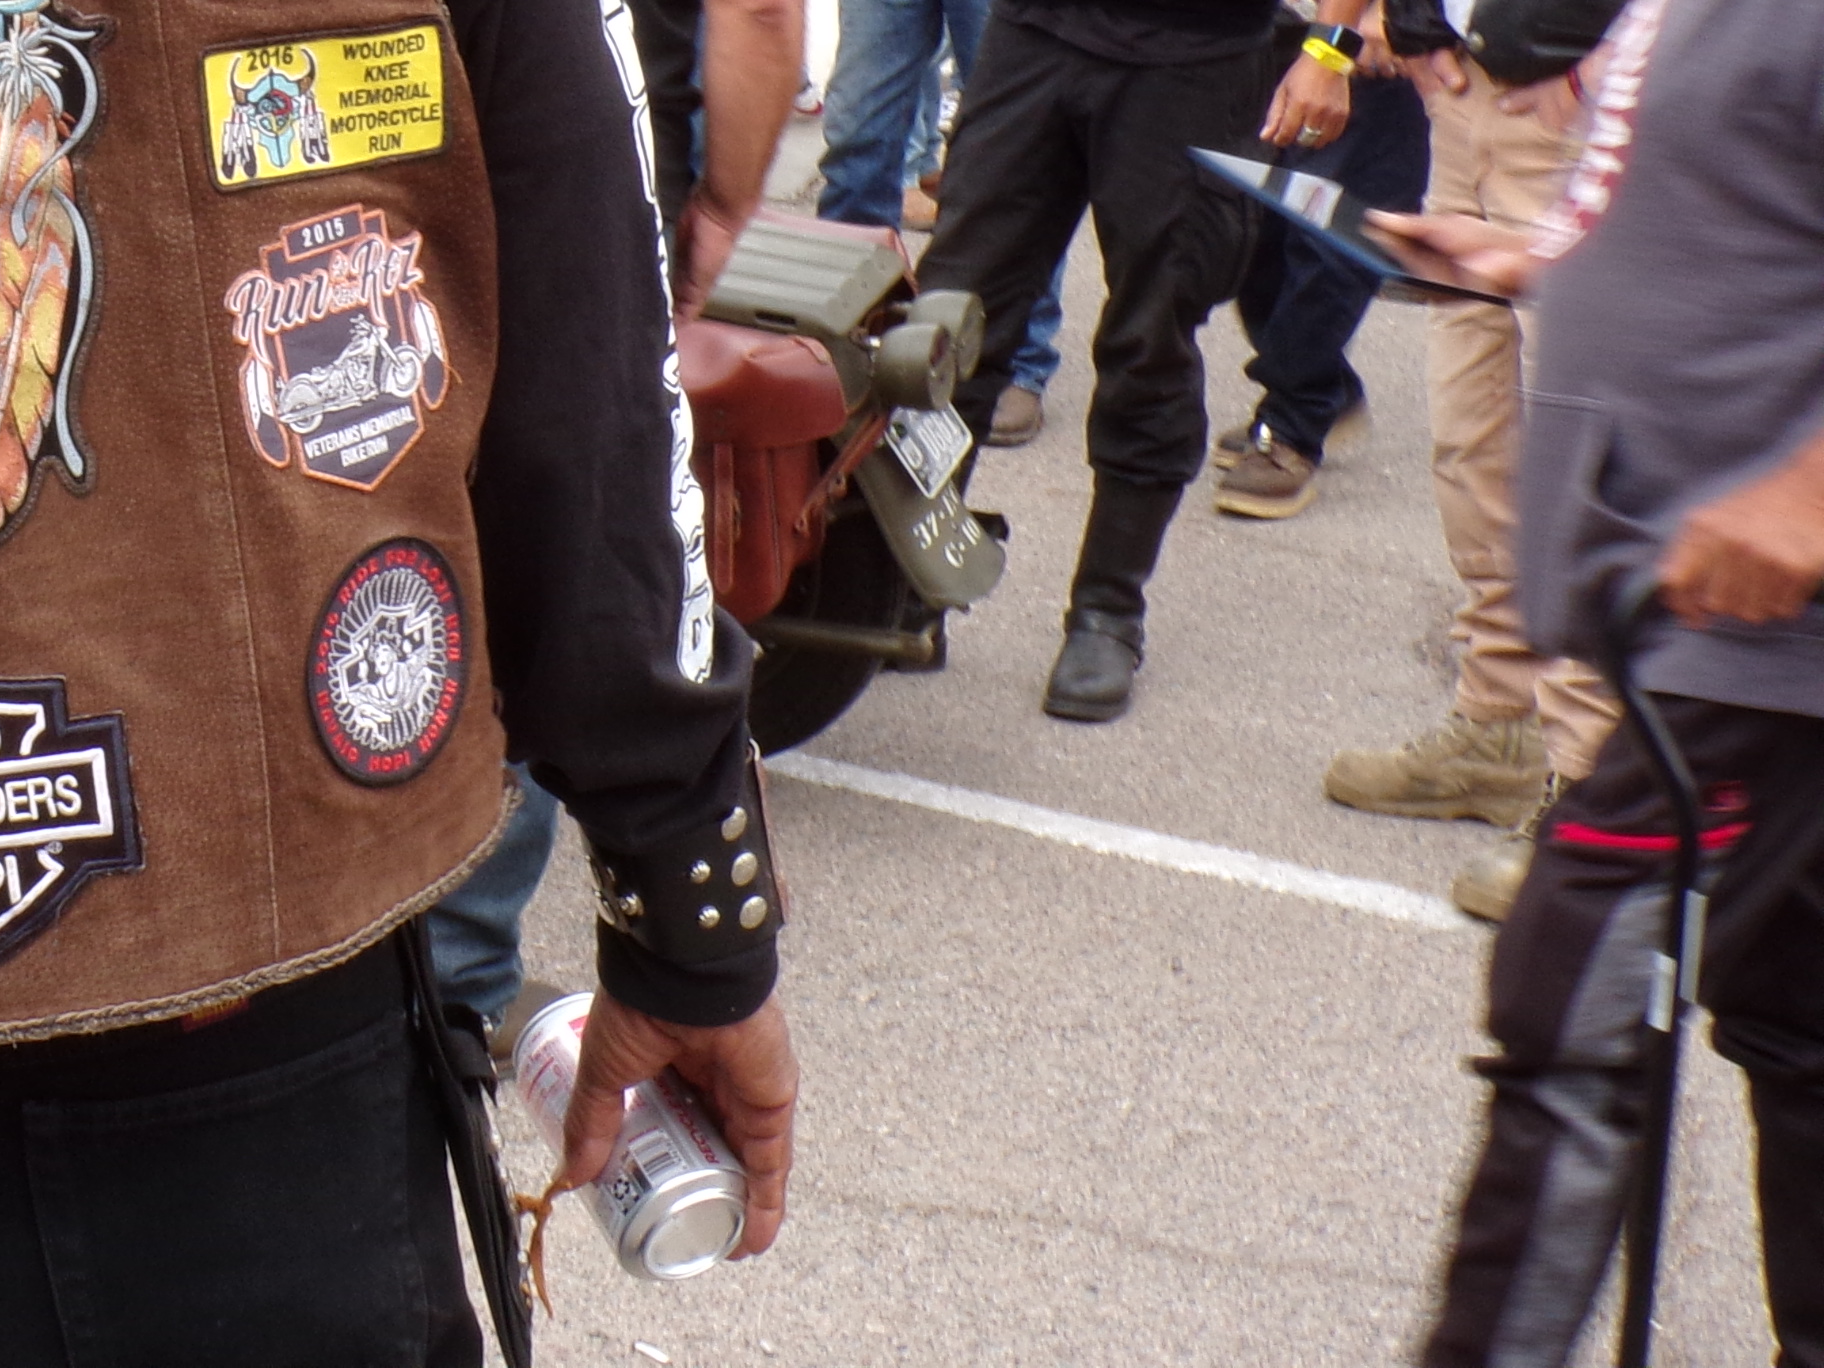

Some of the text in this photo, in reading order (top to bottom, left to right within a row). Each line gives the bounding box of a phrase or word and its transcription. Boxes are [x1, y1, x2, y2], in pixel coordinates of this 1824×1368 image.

[246, 45, 294, 73] 2016
[342, 34, 426, 60] WOUNDED
[364, 61, 410, 83] KNEE
[339, 81, 431, 109] MEMORIAL
[330, 103, 441, 135] MOTORCYCLE
[369, 132, 402, 153] RUN
[301, 217, 345, 248] 2015
[229, 272, 328, 363] Run
[303, 405, 416, 460] VETERANS MEMORIAL
[367, 749, 414, 774] HOPI
